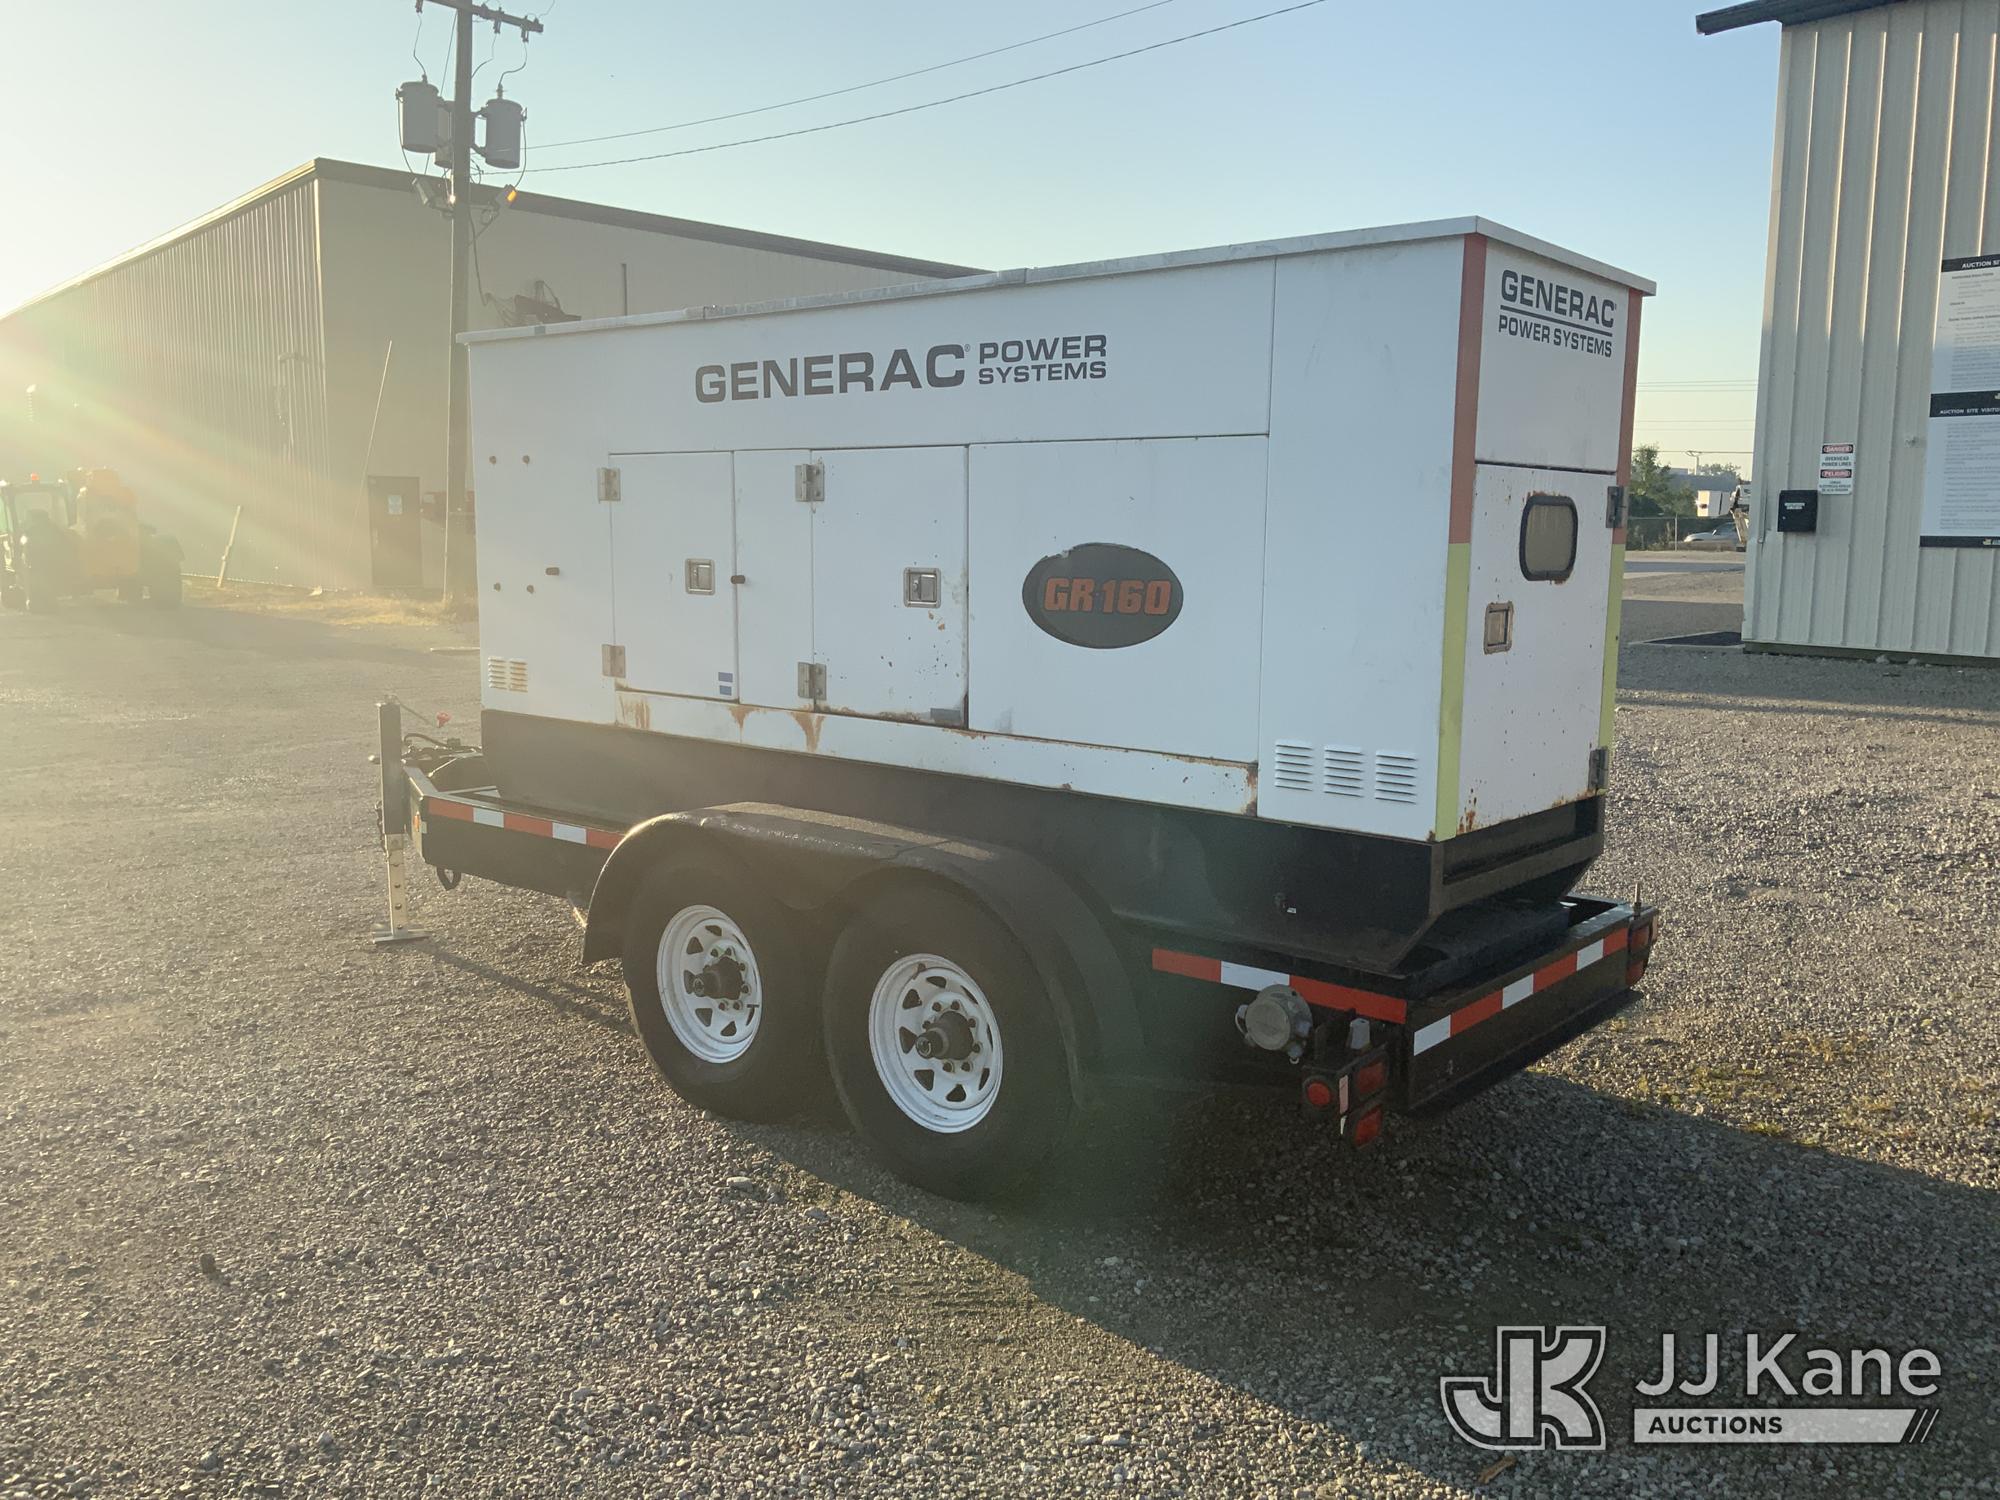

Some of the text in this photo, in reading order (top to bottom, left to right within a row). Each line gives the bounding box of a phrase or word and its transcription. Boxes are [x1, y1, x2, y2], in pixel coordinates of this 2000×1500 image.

[1961, 260, 1992, 269] AUCTION
[1501, 269, 1615, 328] GENERAC
[979, 334, 1107, 364] POWER
[1498, 315, 1612, 358] POWER SYSTEMS
[695, 344, 965, 403] GENERAC
[978, 361, 1107, 385] SYSTEMS
[1044, 578, 1171, 615] GR160
